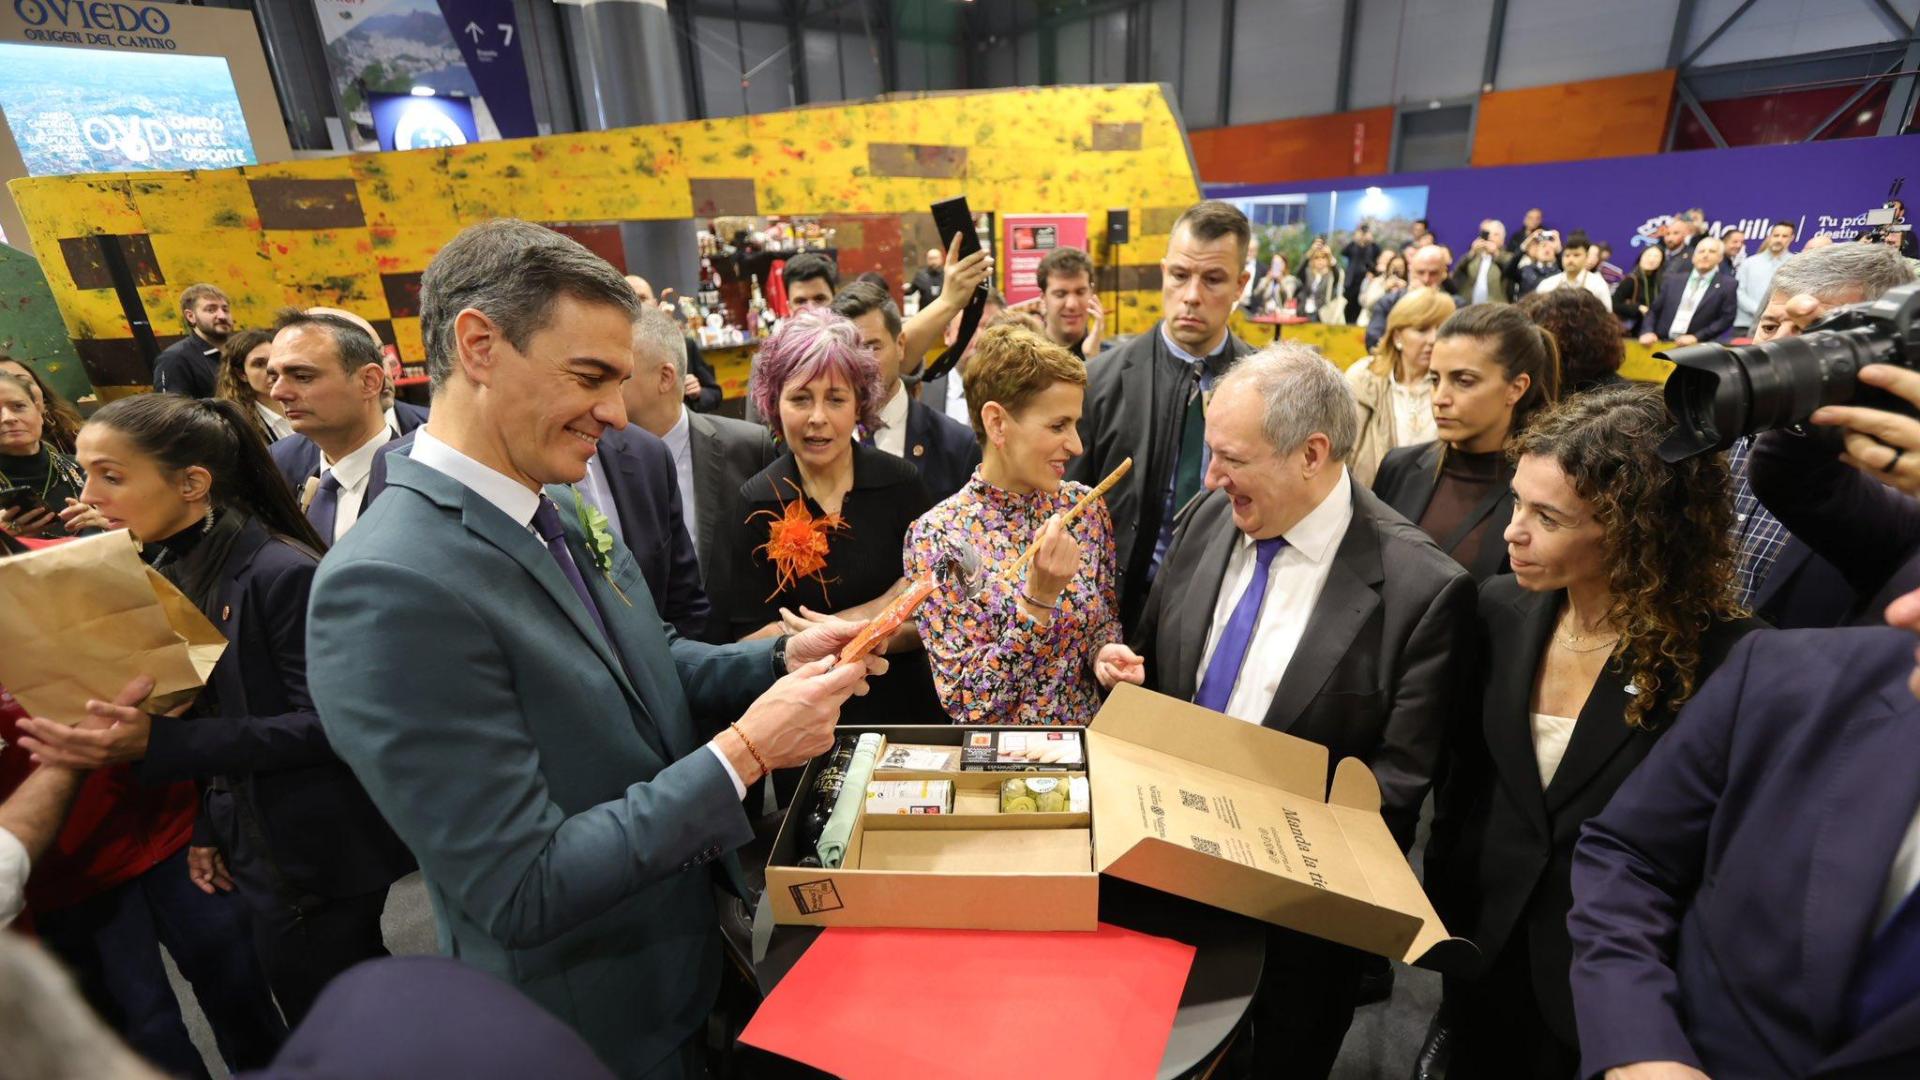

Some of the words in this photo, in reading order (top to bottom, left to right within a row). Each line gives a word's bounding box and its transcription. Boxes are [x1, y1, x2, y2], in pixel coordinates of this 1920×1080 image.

[14, 0, 170, 35] OVIEDO
[24, 28, 83, 44] ORIGEN
[86, 32, 115, 48] DEL
[117, 34, 177, 50] CAMINO
[497, 23, 513, 47] 7
[169, 116, 224, 131] OVIEDO
[176, 132, 207, 146] VIVE
[208, 133, 226, 147] EL
[182, 148, 247, 162] DEPORTE
[1703, 218, 1773, 240] Melill
[1818, 215, 1838, 227] Tu
[1814, 228, 1859, 239] destin
[1282, 807, 1312, 853] Manda
[1302, 854, 1319, 869] la
[1309, 871, 1328, 889] tie
